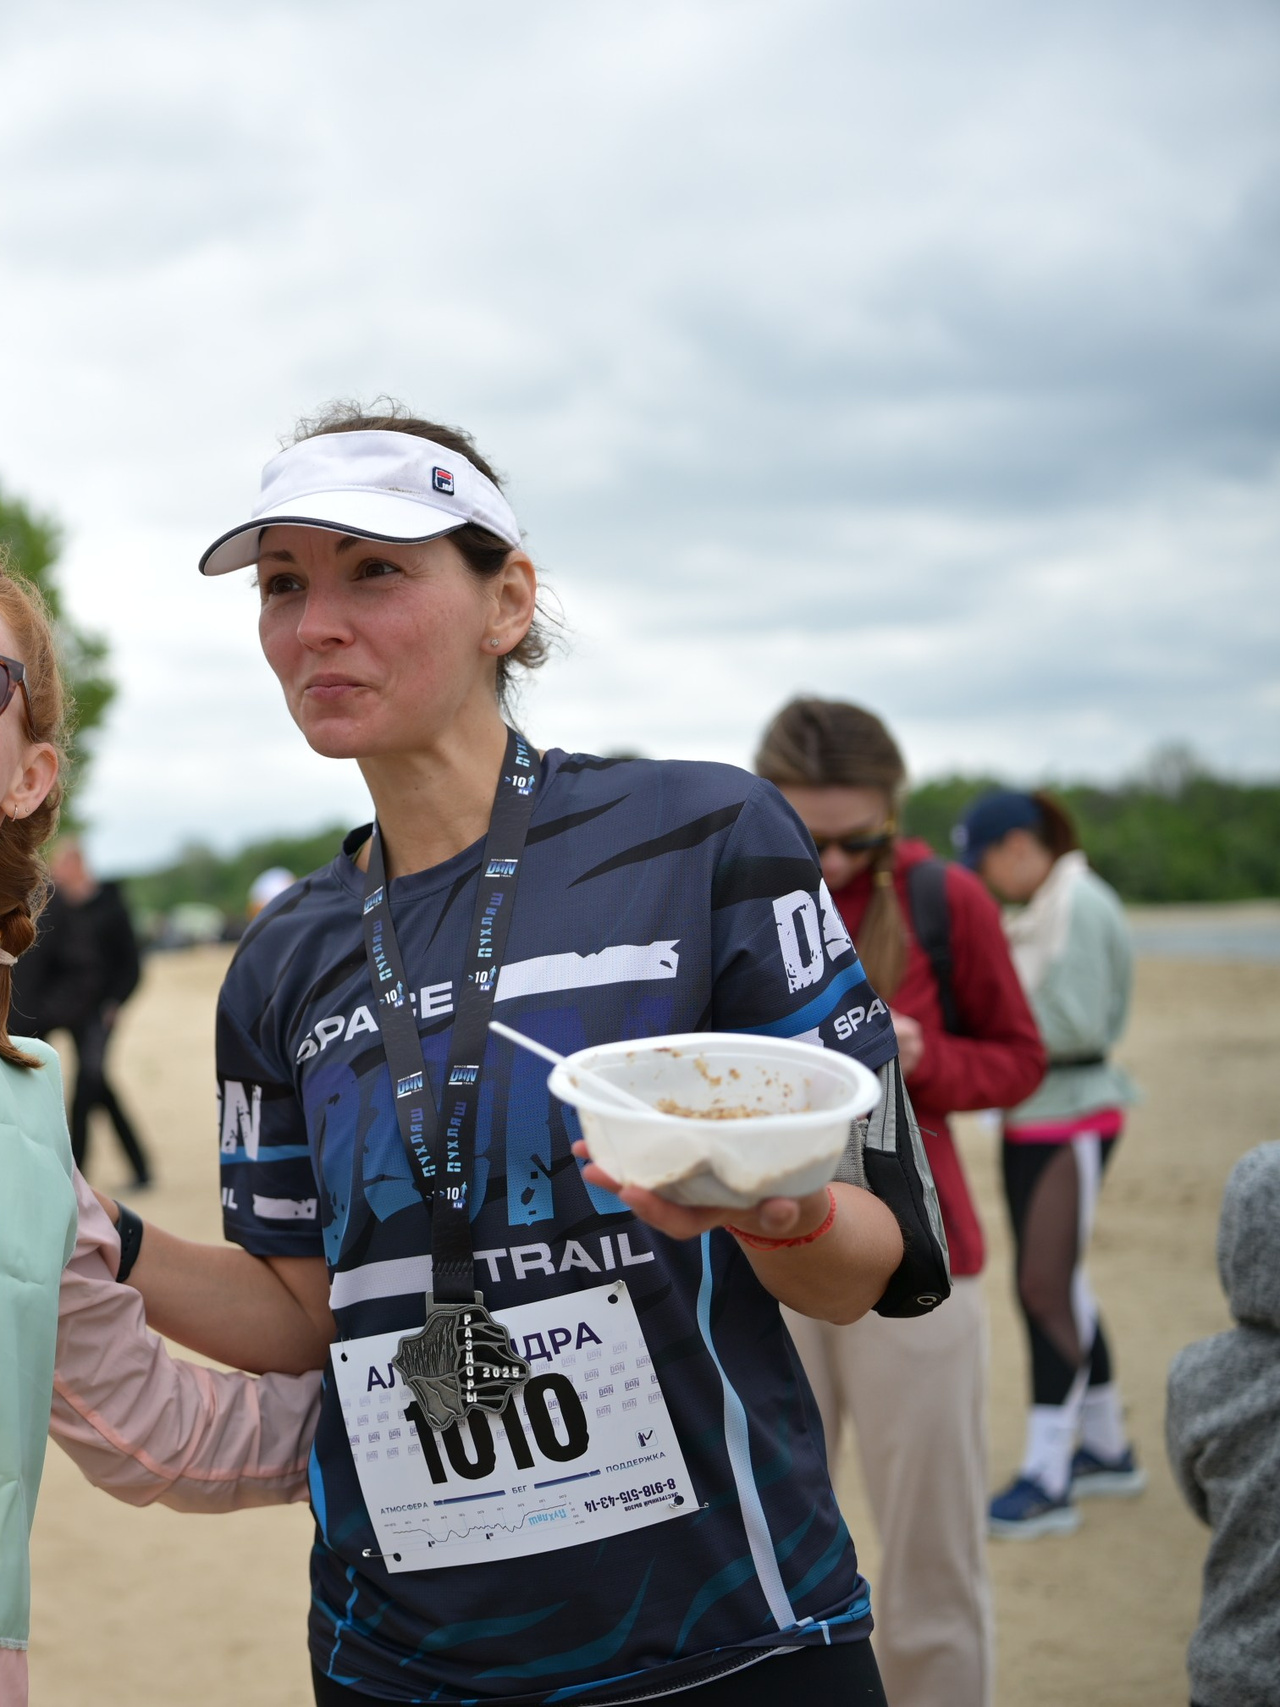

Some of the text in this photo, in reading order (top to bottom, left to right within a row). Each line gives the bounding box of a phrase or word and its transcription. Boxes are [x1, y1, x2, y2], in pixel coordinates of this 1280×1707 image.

[833, 998, 888, 1042] SPA
[447, 1102, 468, 1173] ПУХЛЯШ
[473, 1233, 655, 1283] TRAIL
[482, 1366, 520, 1378] 2025
[404, 1372, 589, 1485] 1010
[605, 1451, 667, 1474] ПОДДЕРЖКА
[511, 1484, 528, 1495] БЕГ
[584, 1478, 677, 1513] 8-918-515-43-14
[380, 1502, 429, 1515] АТМОСФЕРА
